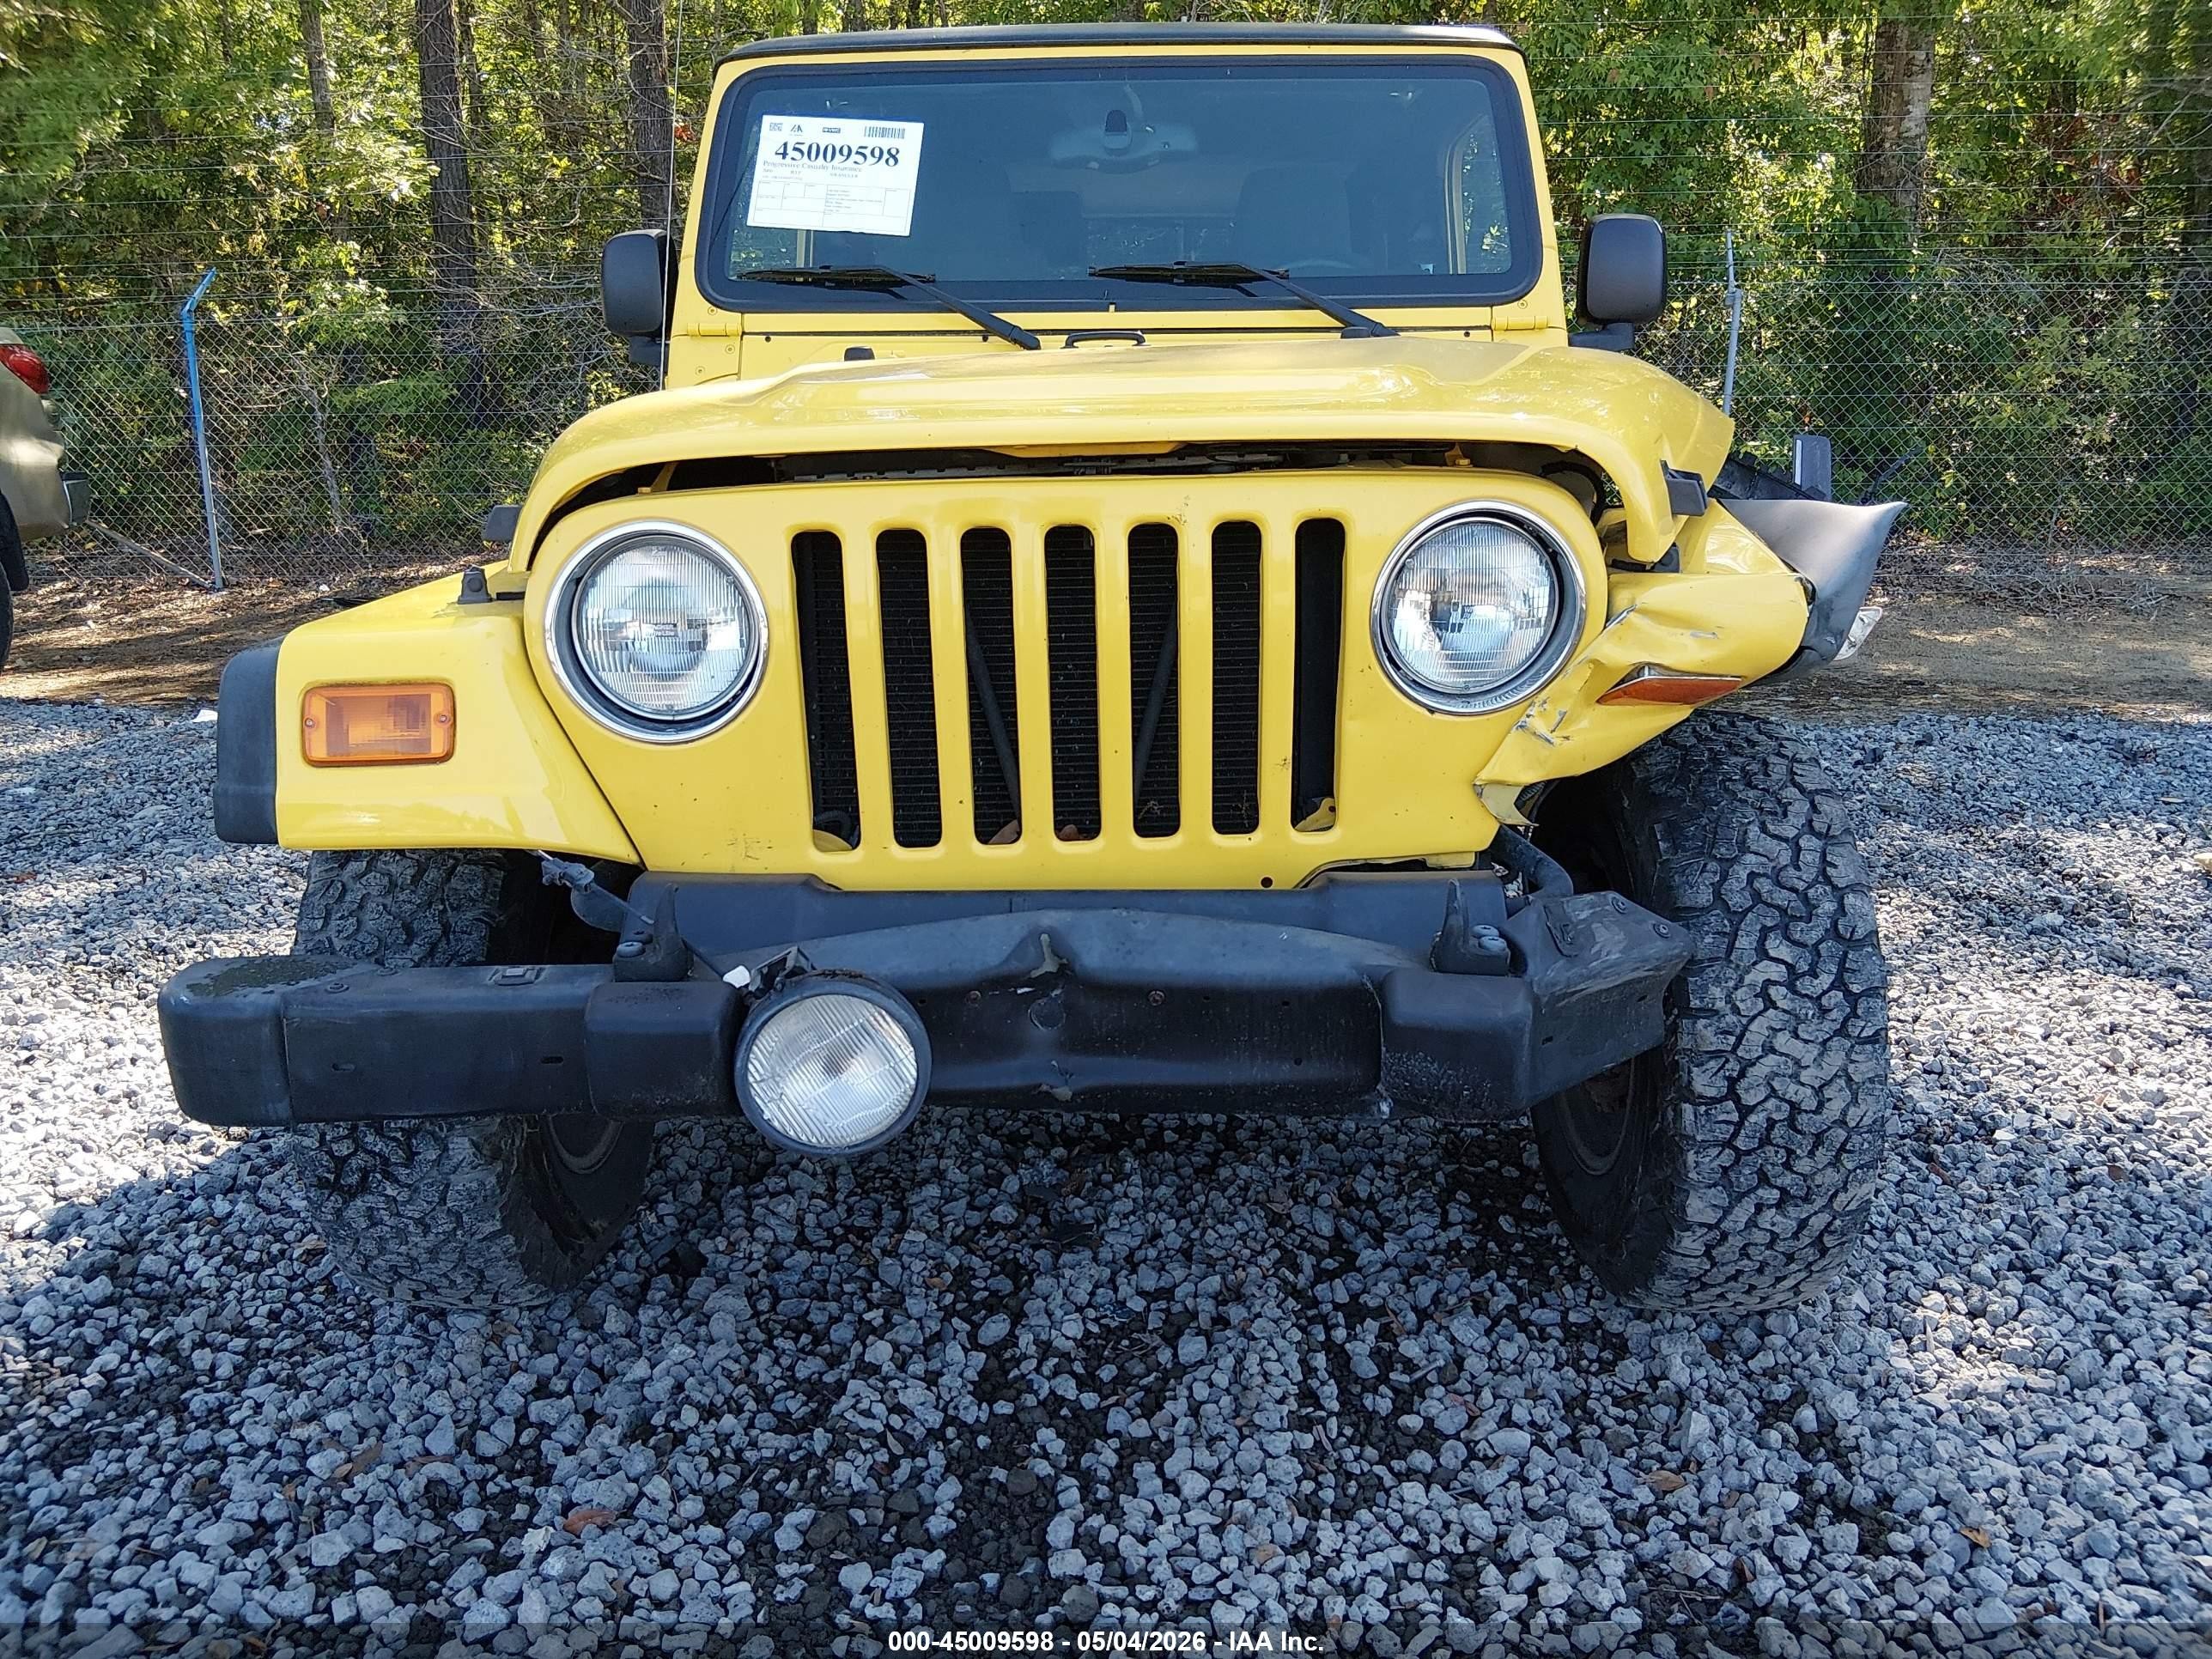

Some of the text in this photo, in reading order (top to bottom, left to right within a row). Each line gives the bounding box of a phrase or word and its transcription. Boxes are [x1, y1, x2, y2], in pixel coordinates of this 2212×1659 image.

[775, 141, 900, 167] 45009598
[763, 160, 800, 169] Progressive
[830, 164, 862, 173] Insurance
